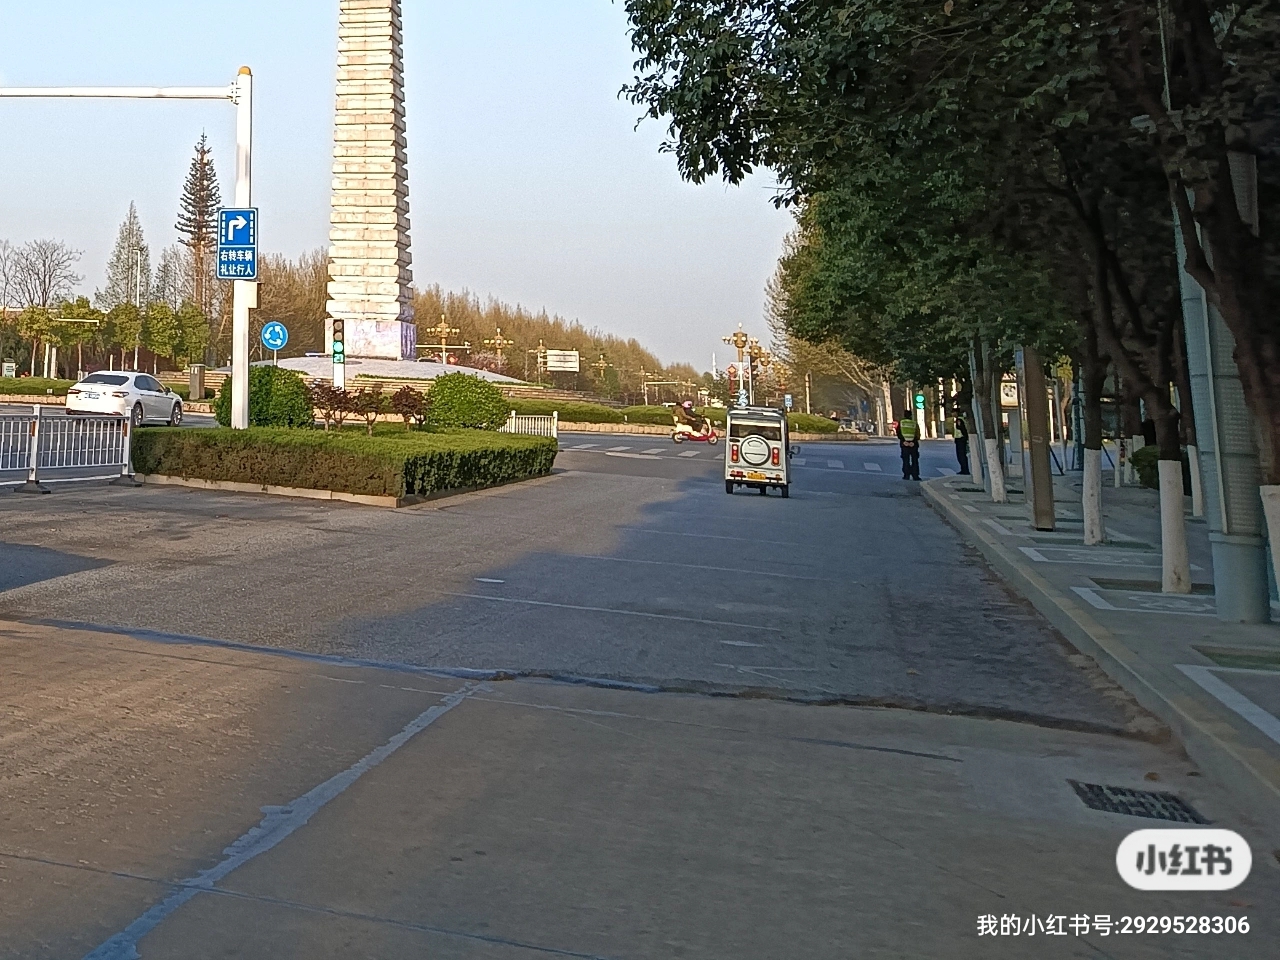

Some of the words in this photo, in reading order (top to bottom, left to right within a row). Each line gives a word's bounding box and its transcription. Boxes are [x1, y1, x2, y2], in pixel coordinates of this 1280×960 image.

[220, 249, 253, 261] 右转车辆
[220, 263, 253, 275] 礼让行人
